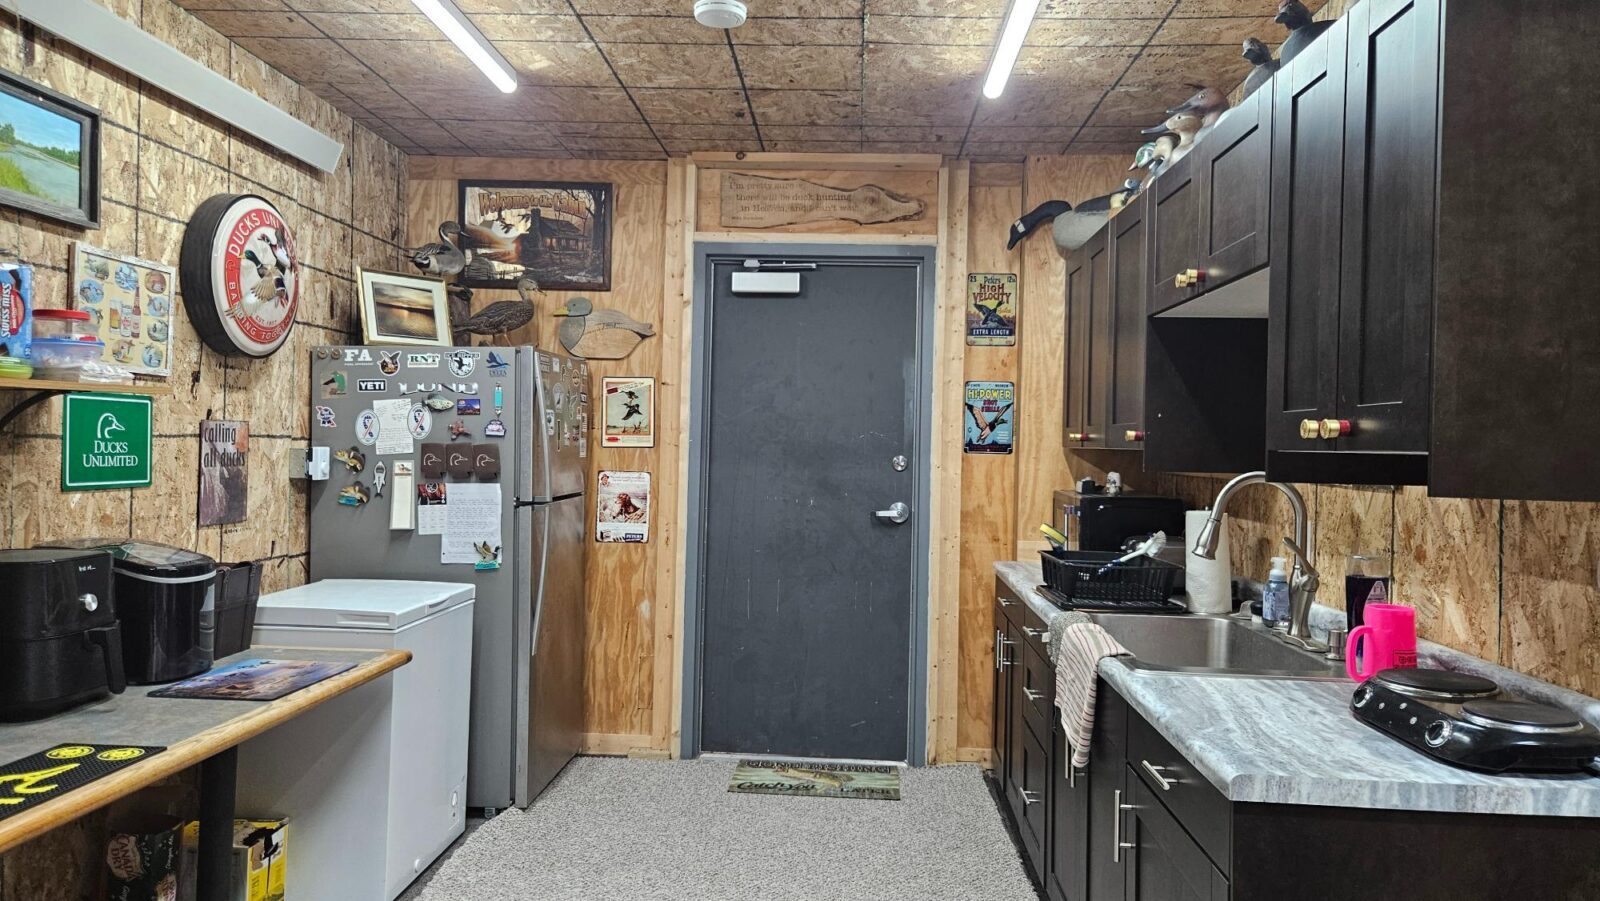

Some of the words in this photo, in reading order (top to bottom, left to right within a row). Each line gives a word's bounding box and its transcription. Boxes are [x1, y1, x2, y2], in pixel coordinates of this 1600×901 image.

[816, 192, 852, 202] hunting
[478, 191, 530, 217] Welcome
[553, 192, 588, 220] Cabin
[228, 211, 261, 258] DUCKS
[979, 283, 1005, 293] HIGH
[972, 292, 1012, 305] VELOCITY
[344, 348, 373, 362] FA
[359, 381, 385, 390] YETI
[204, 423, 237, 445] calling
[82, 454, 139, 468] UNLIMITED
[203, 448, 217, 468] all
[220, 448, 246, 467] ducks
[737, 781, 783, 790] Catch
[111, 848, 124, 871] DRY
[117, 834, 137, 881] CANADA
